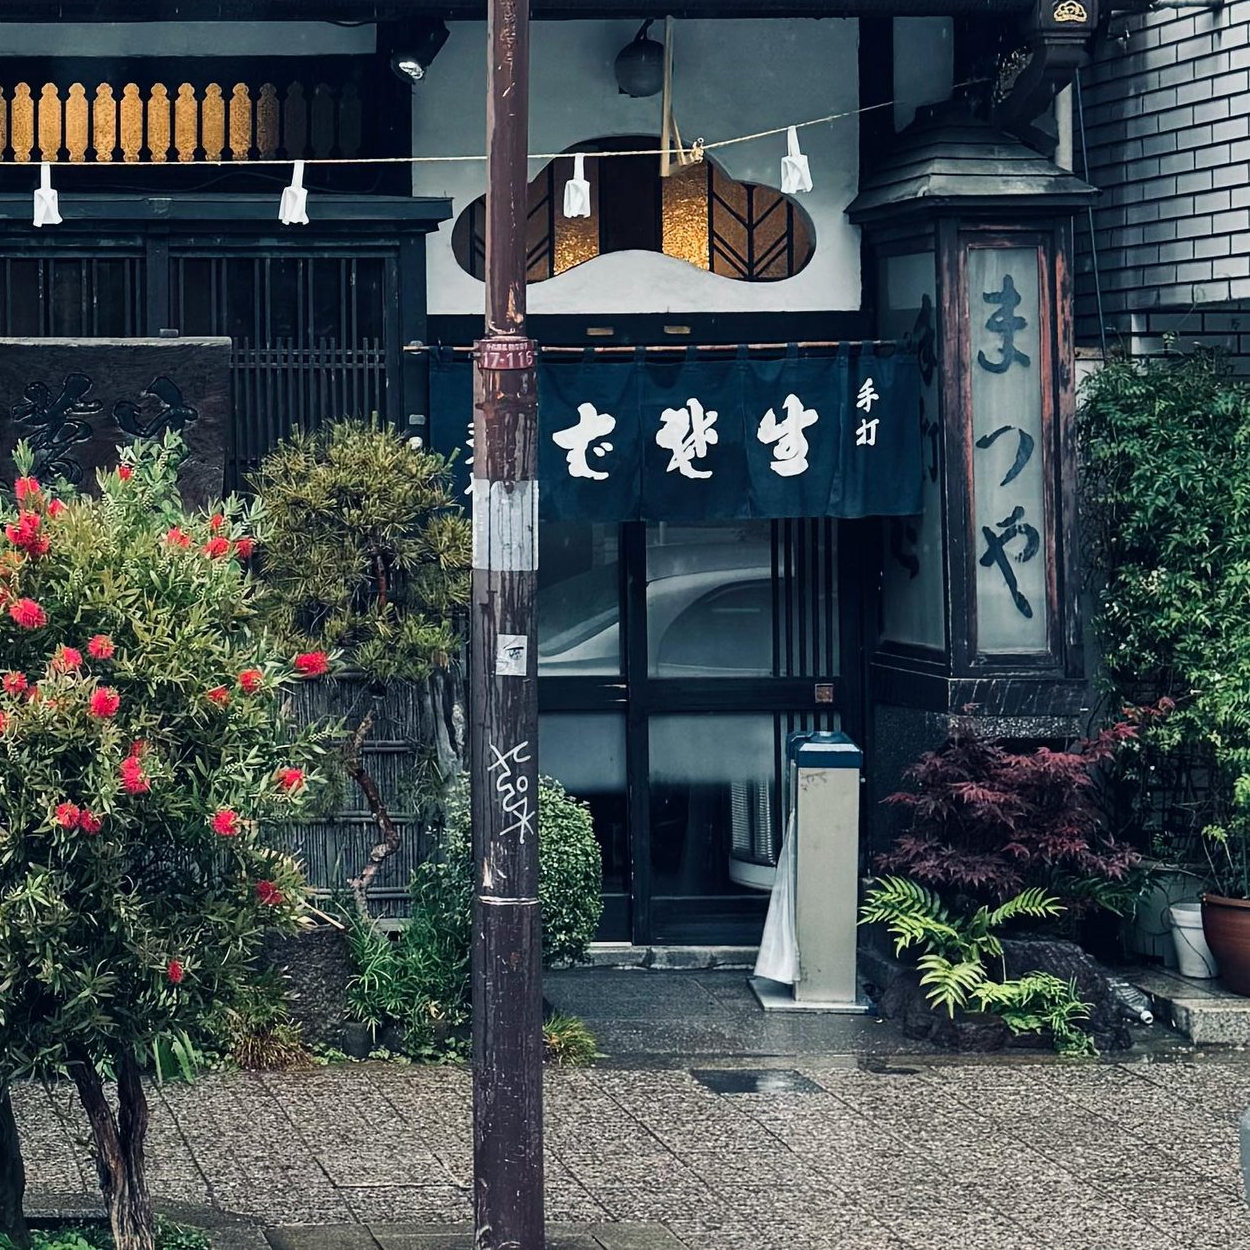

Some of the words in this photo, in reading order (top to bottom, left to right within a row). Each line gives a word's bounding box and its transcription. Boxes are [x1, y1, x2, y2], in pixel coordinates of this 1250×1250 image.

[855, 377, 881, 447] 手打
[975, 273, 1040, 620] まつや
